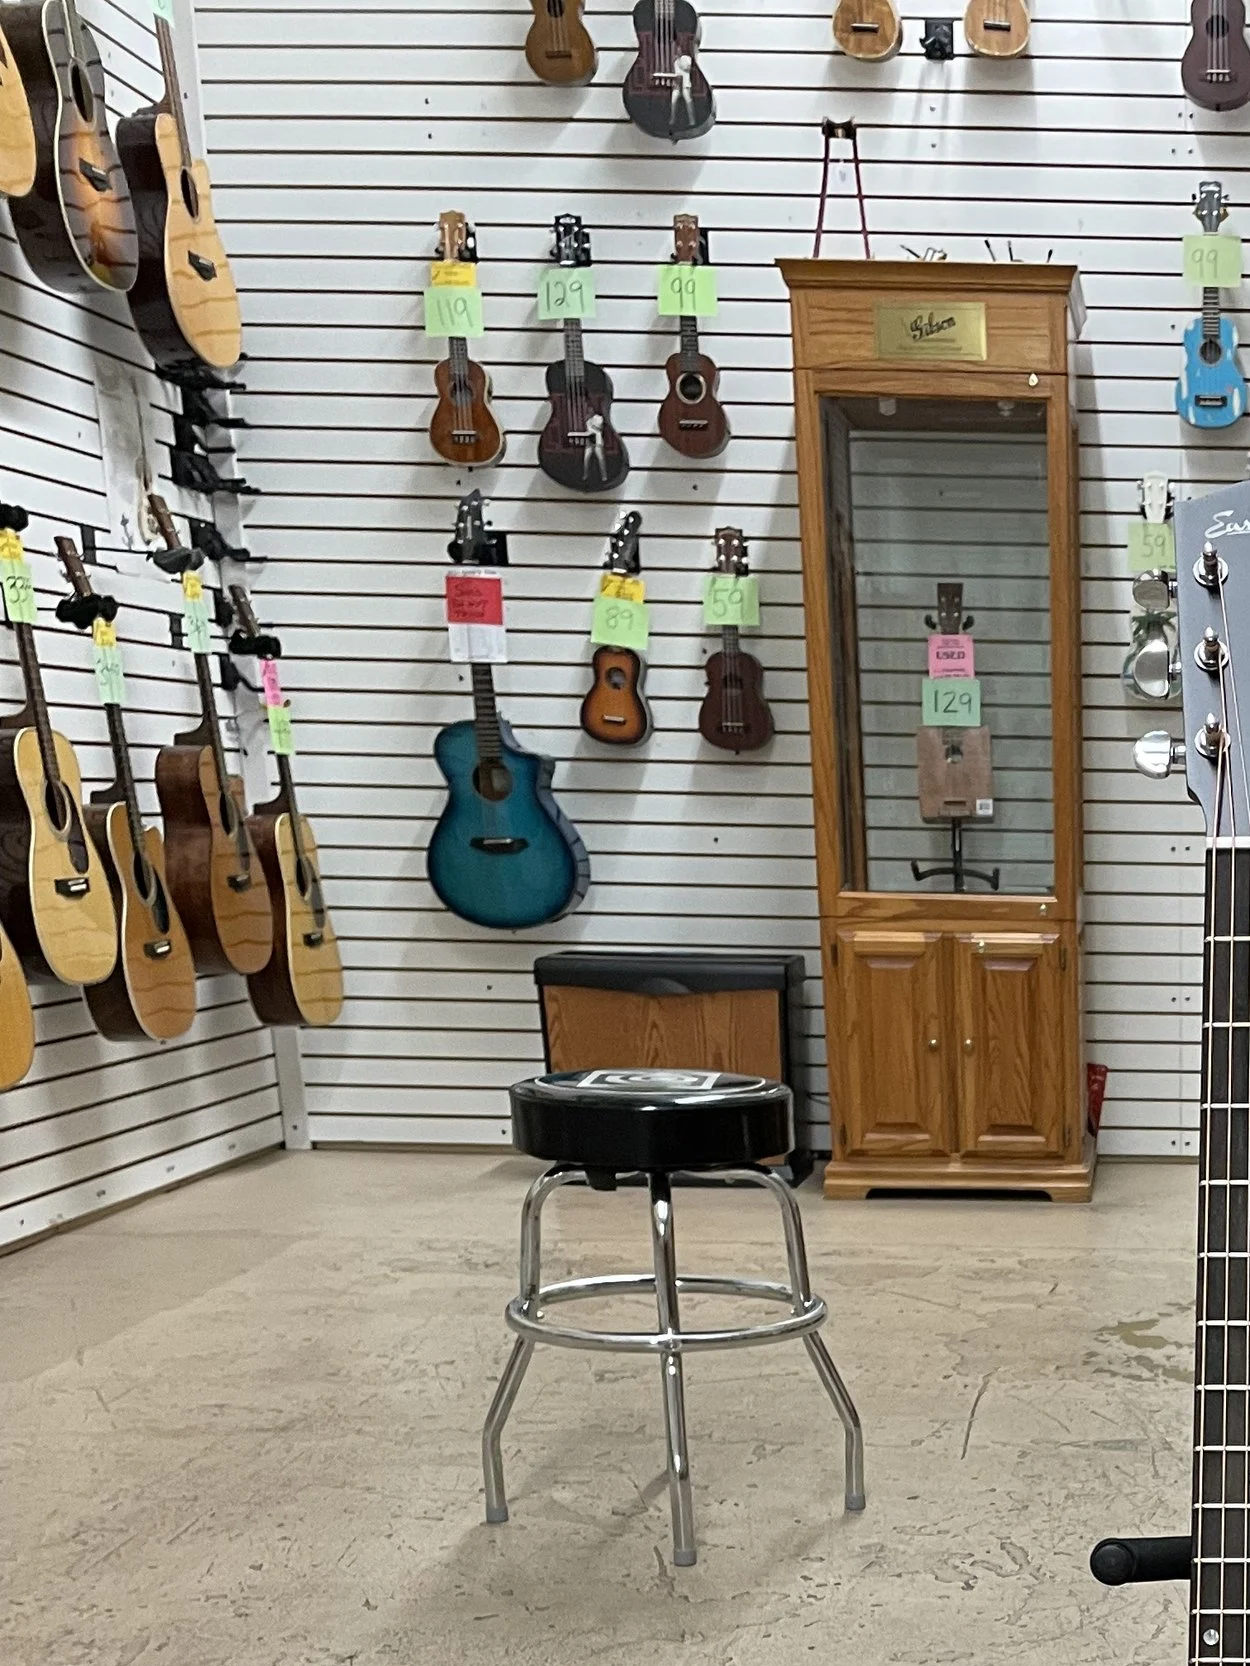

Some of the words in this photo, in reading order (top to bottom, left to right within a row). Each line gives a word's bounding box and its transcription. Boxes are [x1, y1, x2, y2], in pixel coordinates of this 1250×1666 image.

[1191, 248, 1218, 279] 99
[545, 280, 585, 313] 129
[669, 276, 697, 311] 99
[435, 296, 475, 328] 119
[1140, 532, 1167, 558] 59
[605, 604, 635, 631] 89
[712, 588, 745, 619] 59
[933, 689, 972, 714] 129
